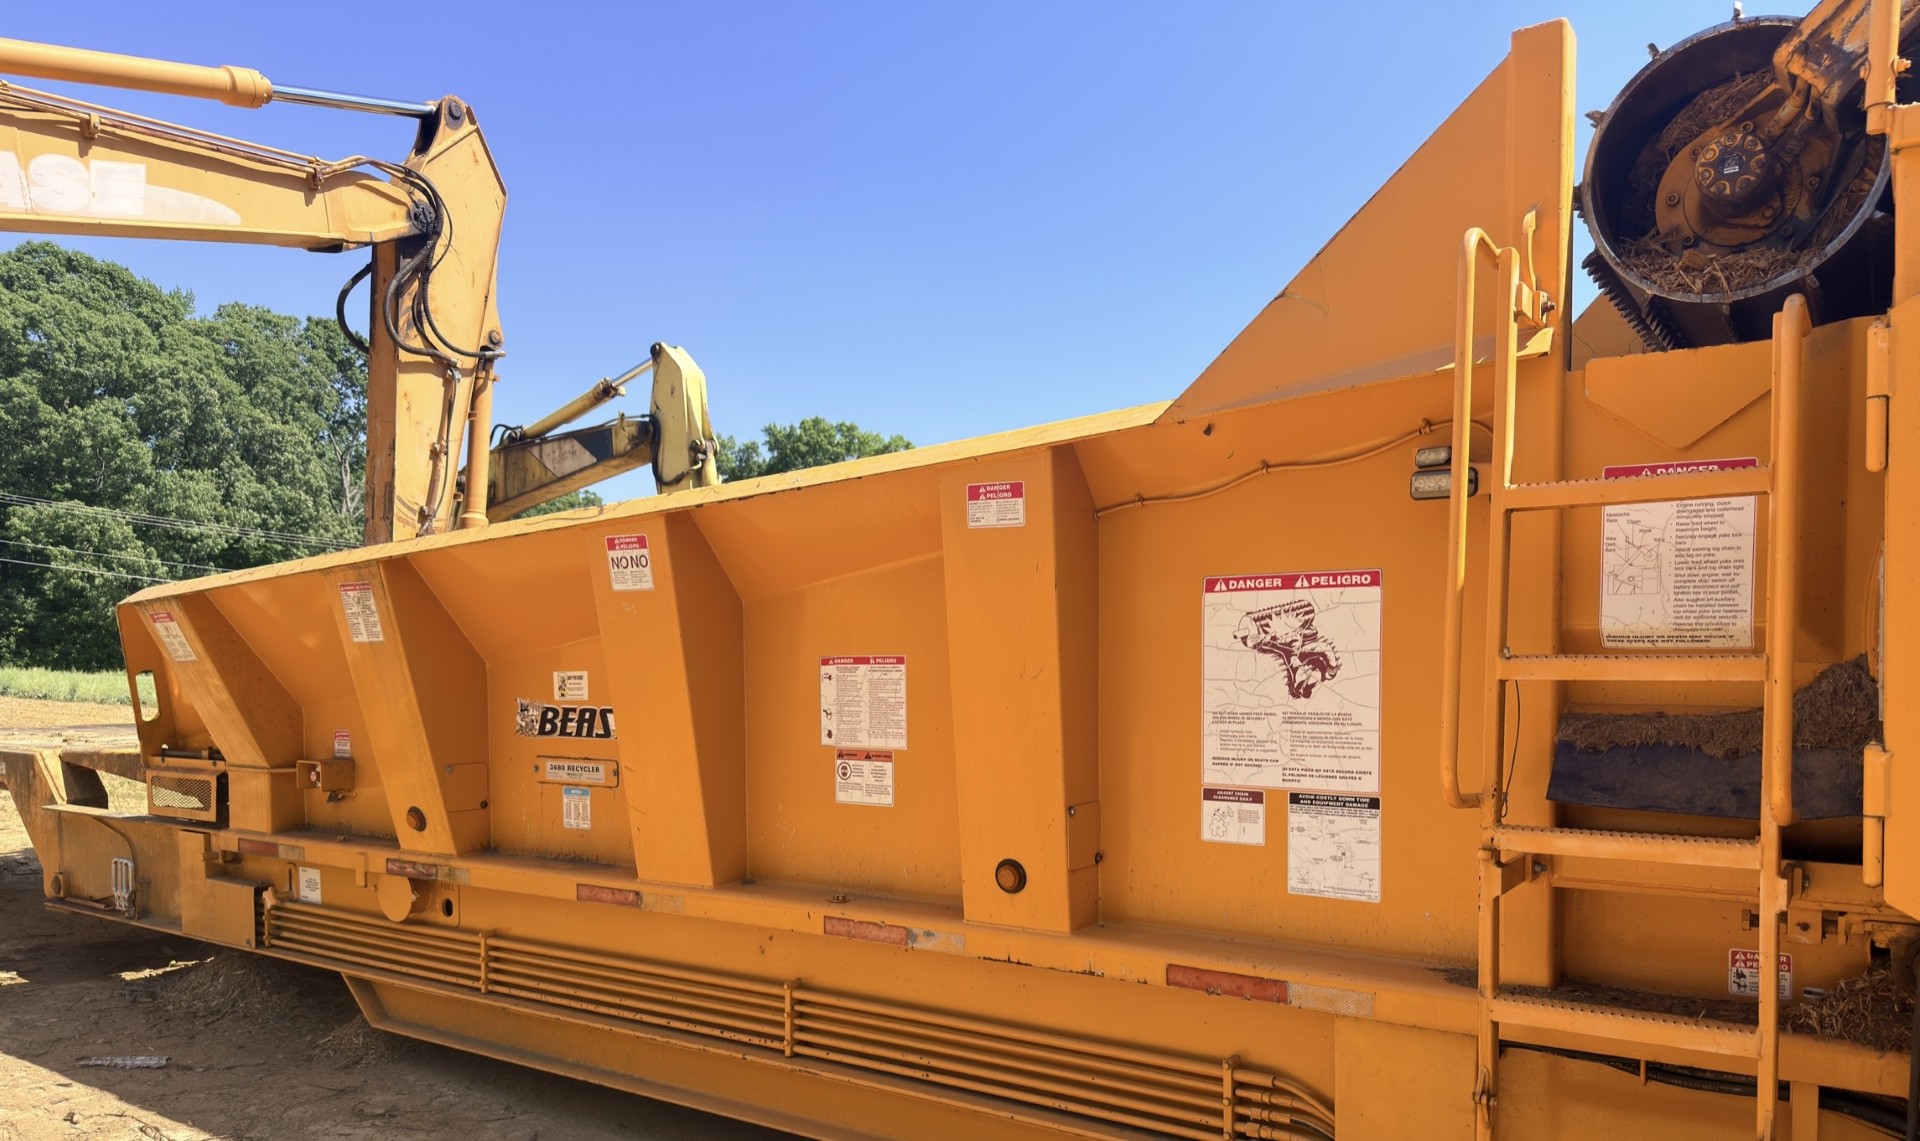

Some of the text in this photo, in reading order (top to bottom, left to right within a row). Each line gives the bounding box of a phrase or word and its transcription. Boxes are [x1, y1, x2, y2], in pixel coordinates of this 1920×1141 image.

[611, 555, 648, 570] NO NO
[1229, 575, 1371, 589] DANGER PELIGRO
[567, 765, 599, 773] RECYCLER
